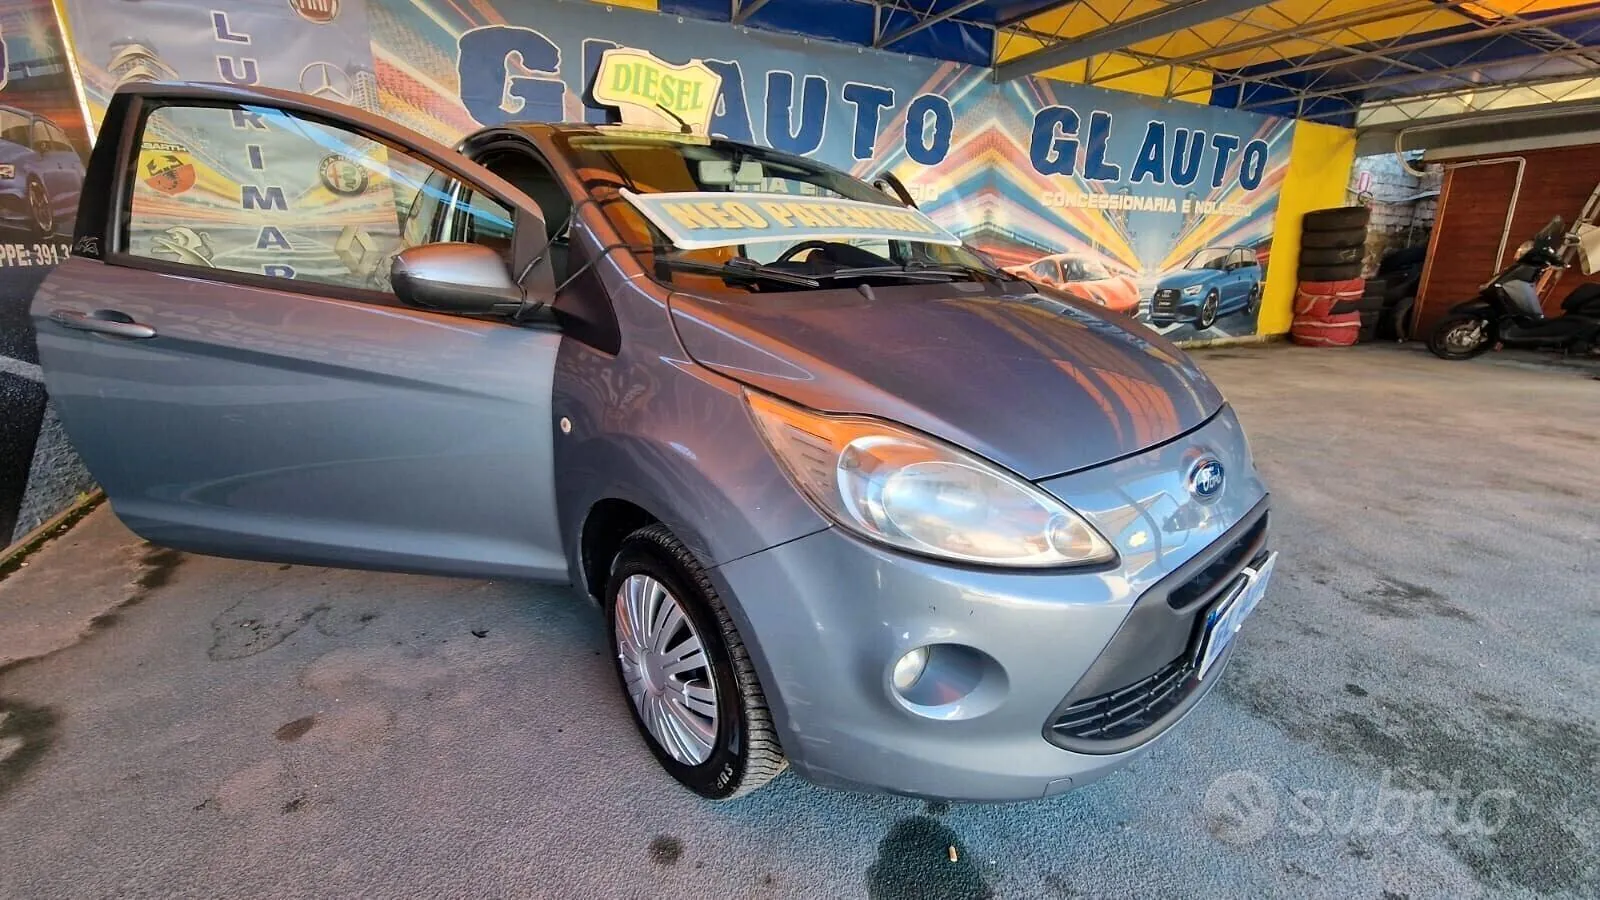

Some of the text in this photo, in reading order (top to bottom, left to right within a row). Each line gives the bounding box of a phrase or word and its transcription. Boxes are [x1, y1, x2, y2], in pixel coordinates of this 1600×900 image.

[611, 63, 704, 111] DIESEL
[1030, 104, 1269, 191] GL AUTO
[660, 202, 769, 230] NEO
[1041, 192, 1176, 213] CONCESSIONARIA
[1181, 200, 1191, 213] E
[33, 243, 59, 266] 391
[60, 243, 73, 260] 3
